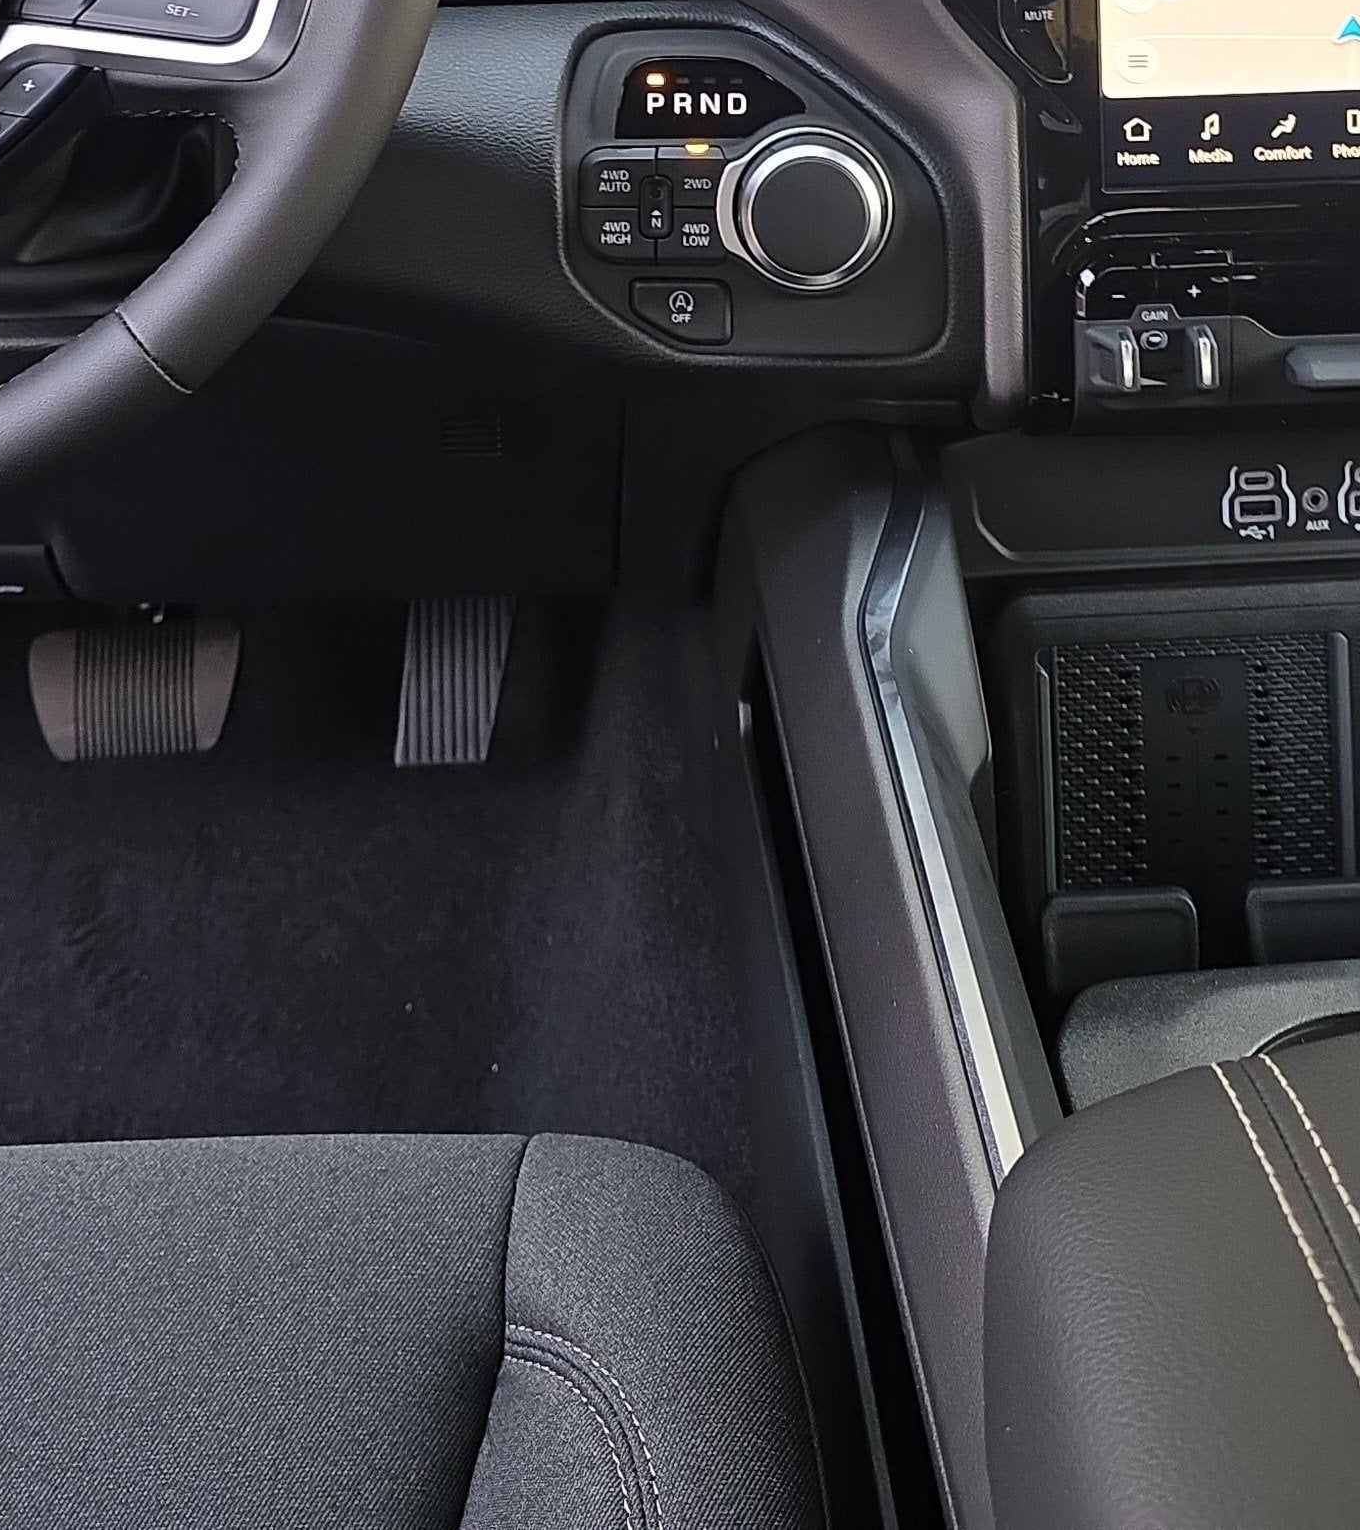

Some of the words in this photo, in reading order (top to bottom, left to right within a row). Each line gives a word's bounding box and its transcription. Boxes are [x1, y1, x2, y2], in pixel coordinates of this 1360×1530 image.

[1024, 10, 1055, 21] MUTE
[1116, 151, 1161, 167] Home
[1188, 148, 1234, 164] Media
[1253, 145, 1314, 162] Comfort
[600, 170, 630, 181] 4WD
[598, 181, 632, 193] AUTO
[683, 178, 713, 190] 2WD
[602, 221, 631, 233] 4WD
[681, 223, 710, 235] 4WD
[600, 233, 632, 245] HIGH
[682, 234, 710, 247] LOW
[671, 313, 692, 324] OFF
[1140, 310, 1169, 321] GAIN
[1305, 520, 1331, 531] AUX
